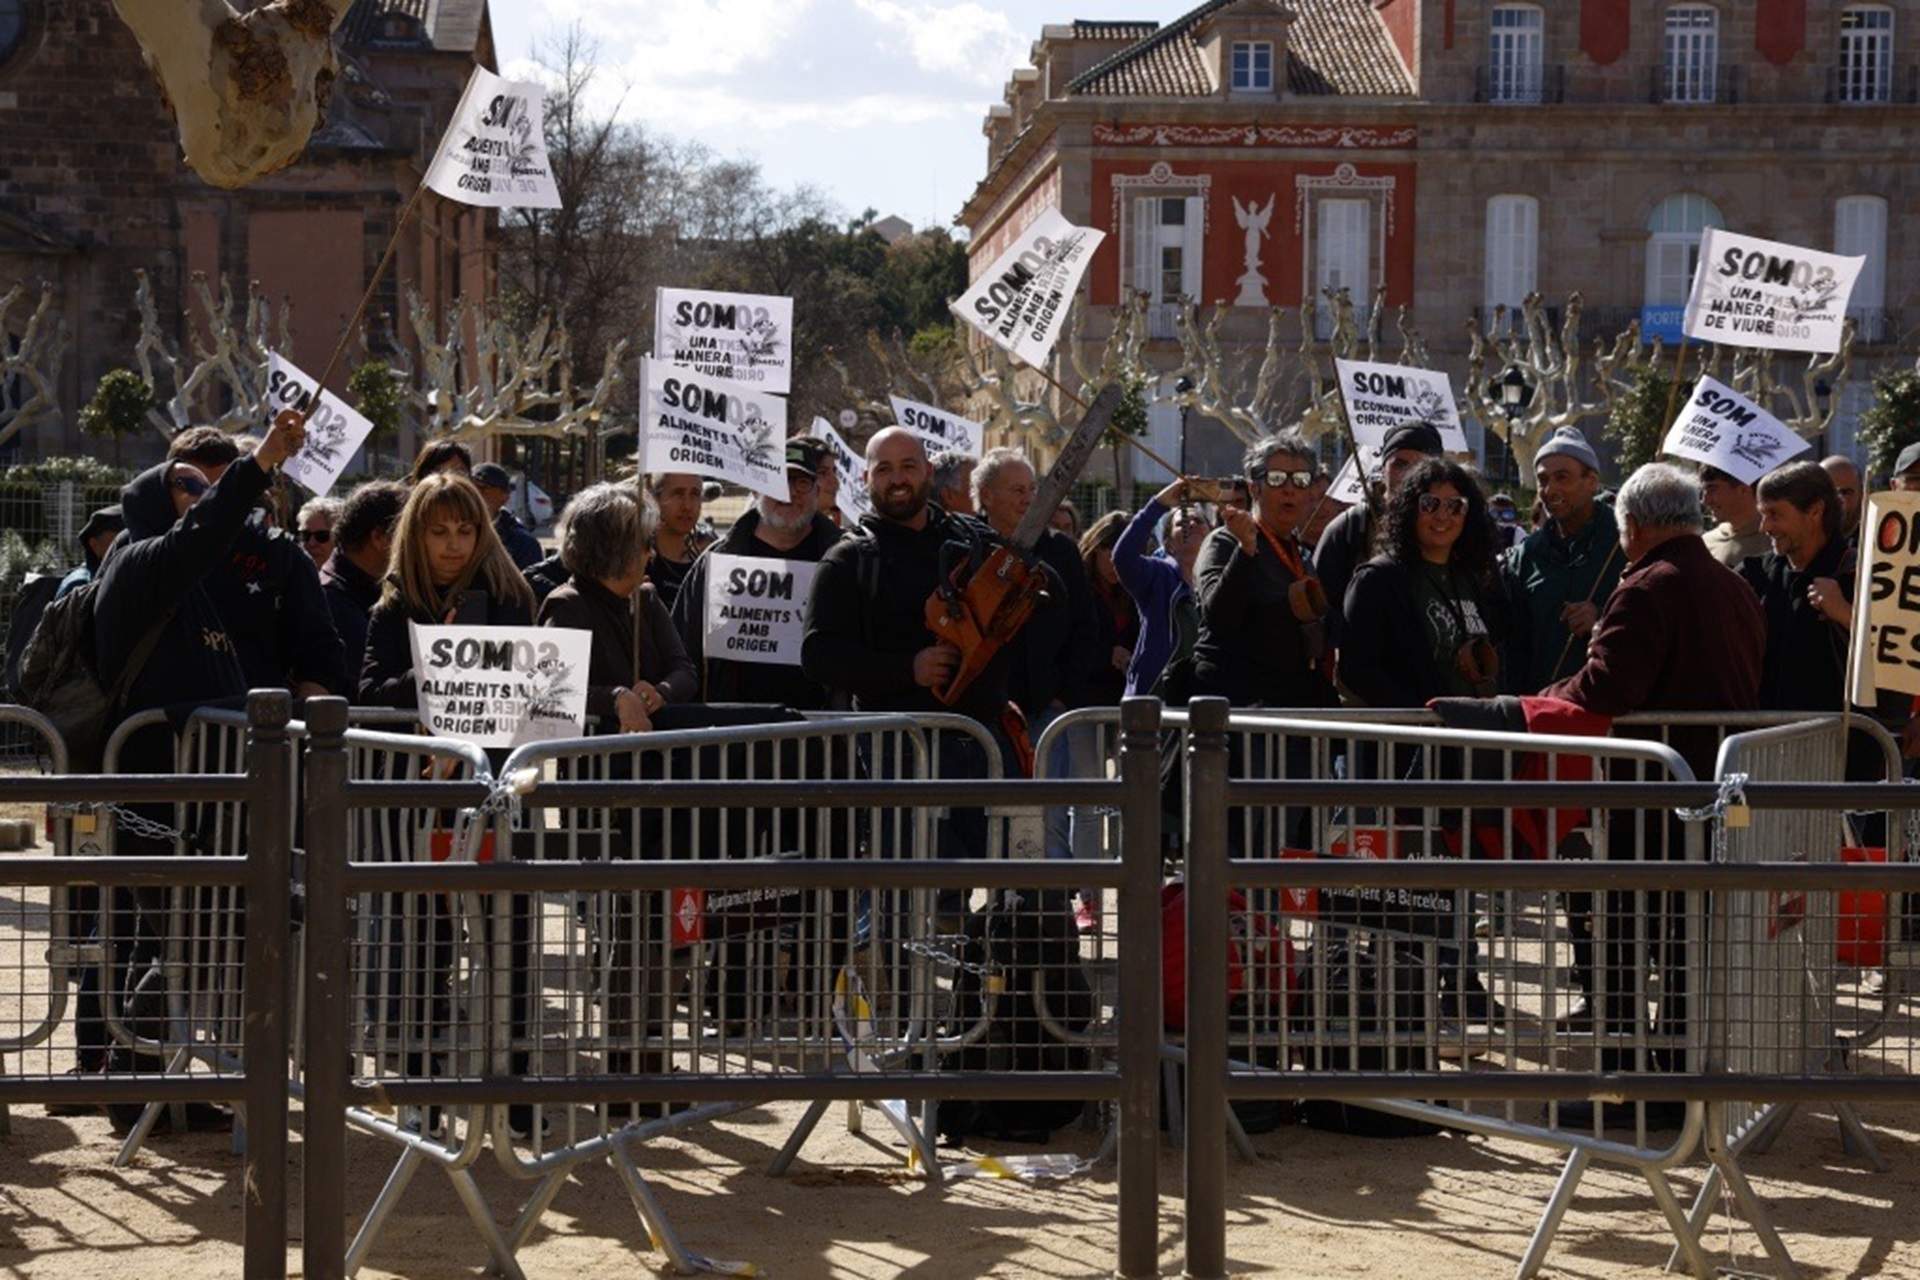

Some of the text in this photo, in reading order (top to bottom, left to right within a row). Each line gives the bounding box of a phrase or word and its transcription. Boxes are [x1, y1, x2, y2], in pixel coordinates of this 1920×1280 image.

[1729, 284, 1763, 303] UNA
[1022, 288, 1046, 328] AMB
[1030, 287, 1064, 343] ORIGEN
[1710, 298, 1777, 320] MANERA
[1704, 314, 1777, 336] DE VIURE
[688, 335, 718, 350] UNA
[673, 348, 733, 365] MANERA
[1353, 399, 1413, 417] ECONOMIA
[1694, 389, 1758, 429] SOM
[658, 413, 730, 445] ALIMENTS
[1691, 413, 1718, 430] UNA
[680, 433, 713, 453] AMB
[669, 447, 725, 470] ORIGEN
[726, 567, 795, 601] SOM
[719, 604, 792, 624] ALIMENTS
[737, 621, 770, 638] AMB
[726, 635, 779, 654] ORIGEN
[421, 679, 512, 700] ALIMENTS
[444, 700, 486, 717] AMB
[432, 714, 497, 736] ORIGEN
